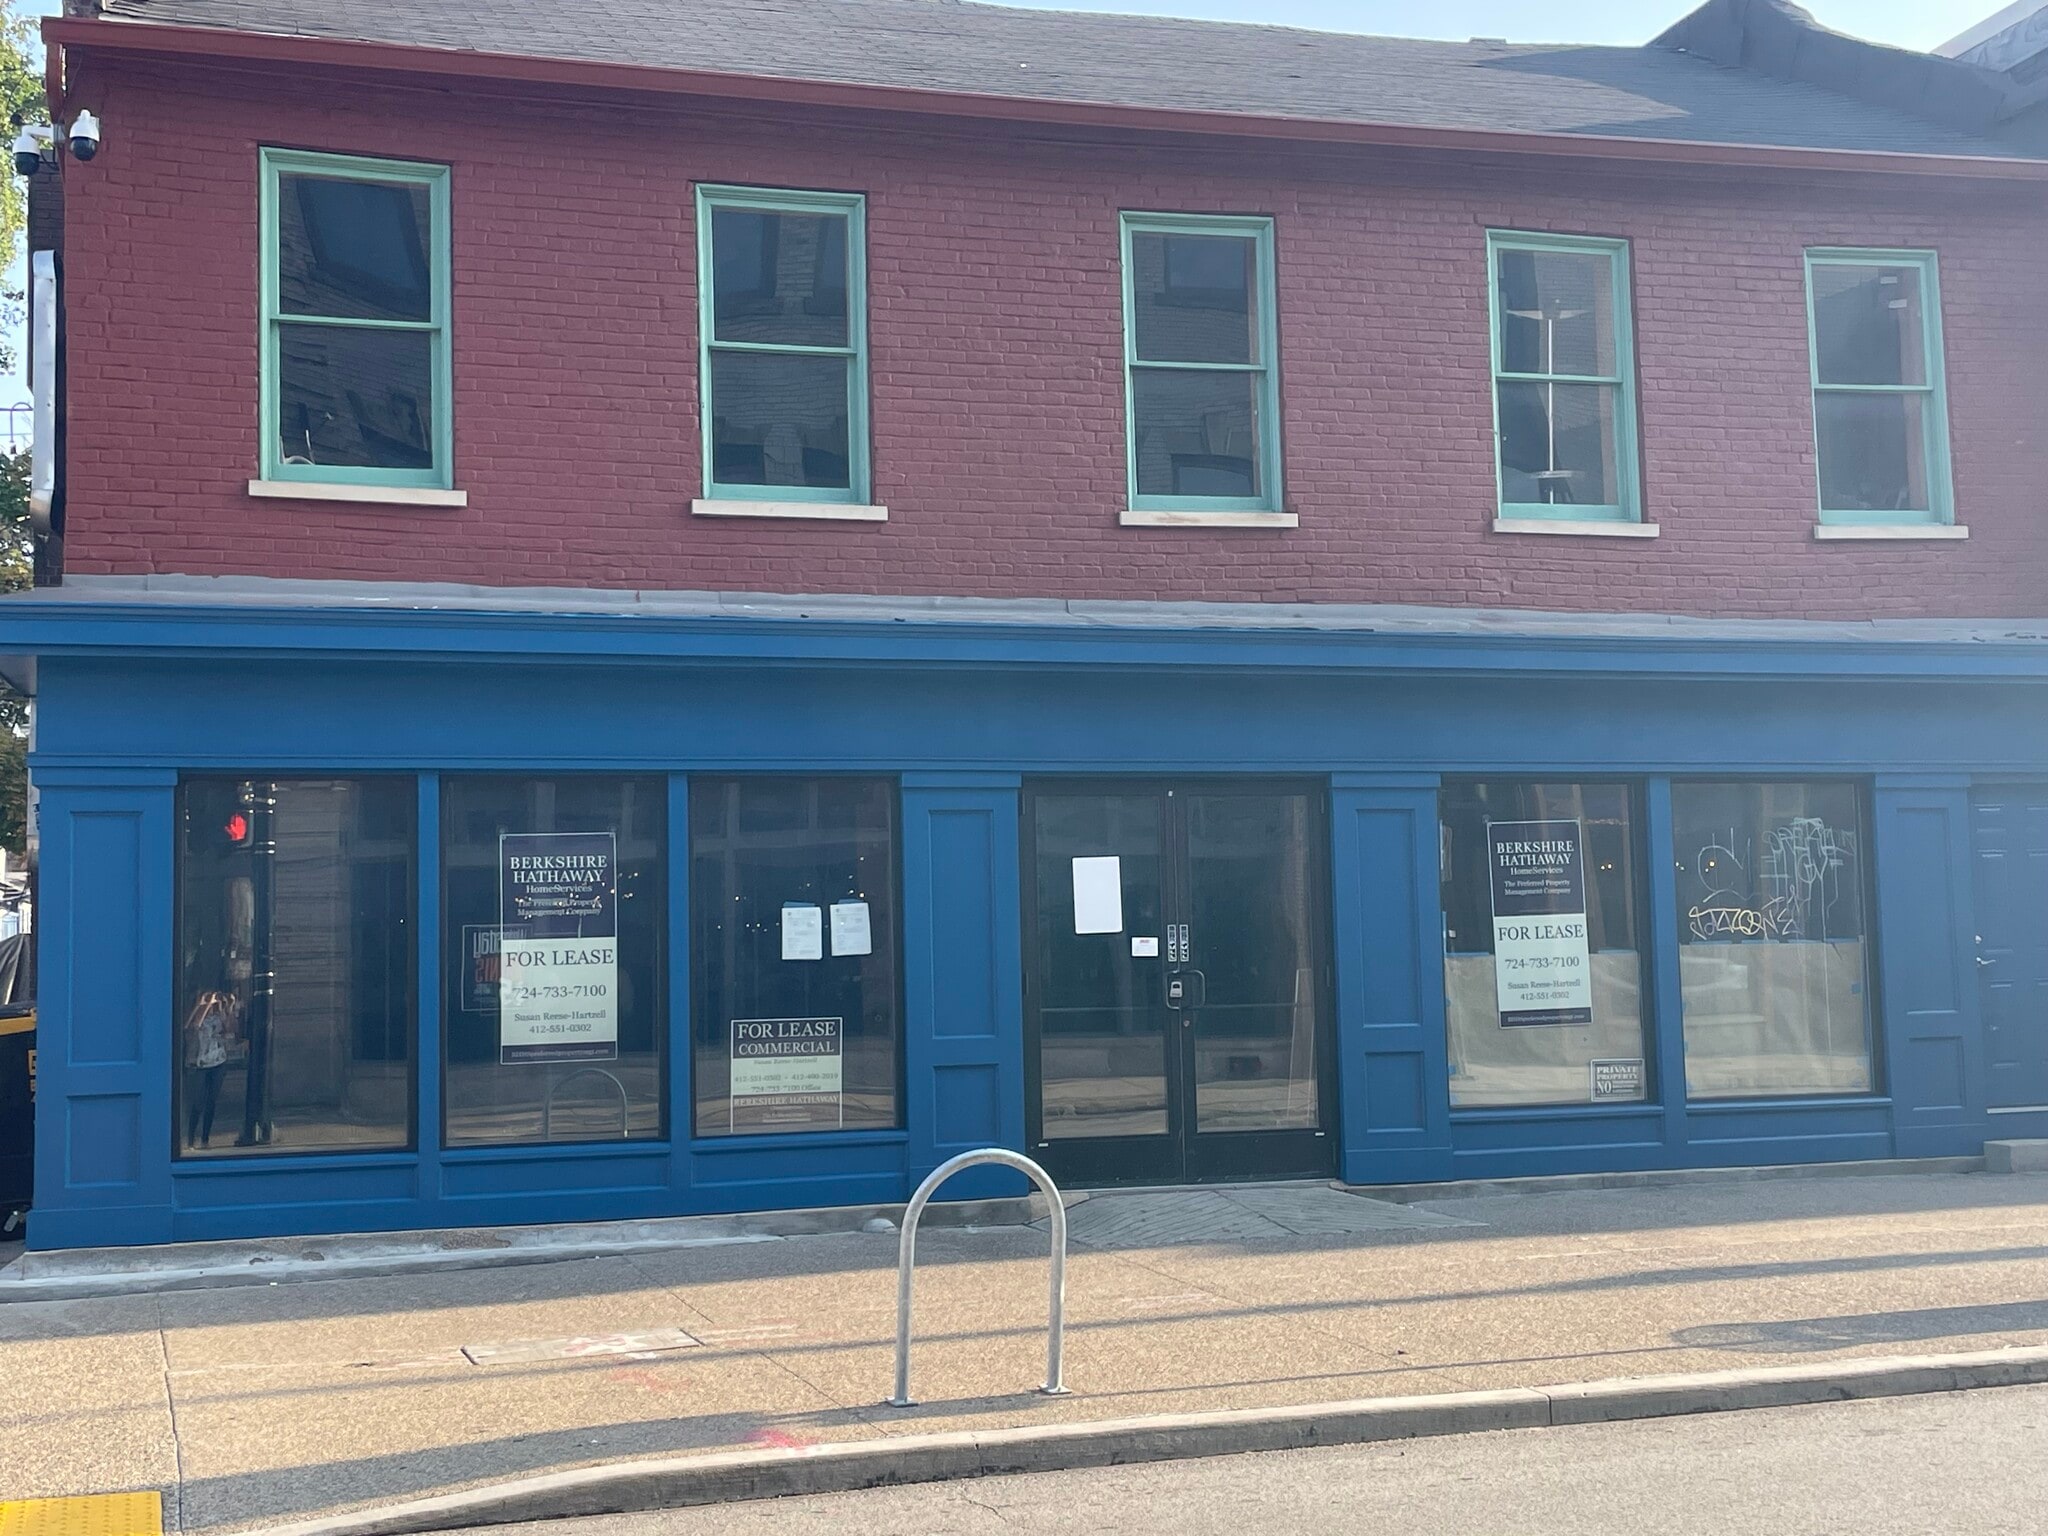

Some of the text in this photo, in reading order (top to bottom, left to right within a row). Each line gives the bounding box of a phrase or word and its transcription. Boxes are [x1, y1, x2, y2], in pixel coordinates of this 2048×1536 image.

[1496, 841, 1574, 854] BERKSHIRE
[510, 855, 607, 869] BERKSHIRE
[1500, 853, 1571, 866] HATHAWAY
[513, 869, 603, 883] HATHAWAY
[1511, 866, 1563, 875] HomeServices
[526, 884, 593, 893] HomeServices
[1498, 924, 1584, 941] FOR LEASE
[506, 949, 614, 967] FOR LEASE
[1505, 957, 1579, 969] 724-733-7100
[513, 985, 606, 999] 724-733-7100
[515, 1013, 540, 1022] Susan
[530, 1024, 592, 1033] 412-551-0302
[738, 1022, 836, 1038] FOR LEASE
[739, 1041, 834, 1055] COMMERCIAL
[1597, 1066, 1637, 1074] PRIVATE
[1597, 1081, 1612, 1094] NO
[790, 1095, 839, 1104] HATHAWAY
